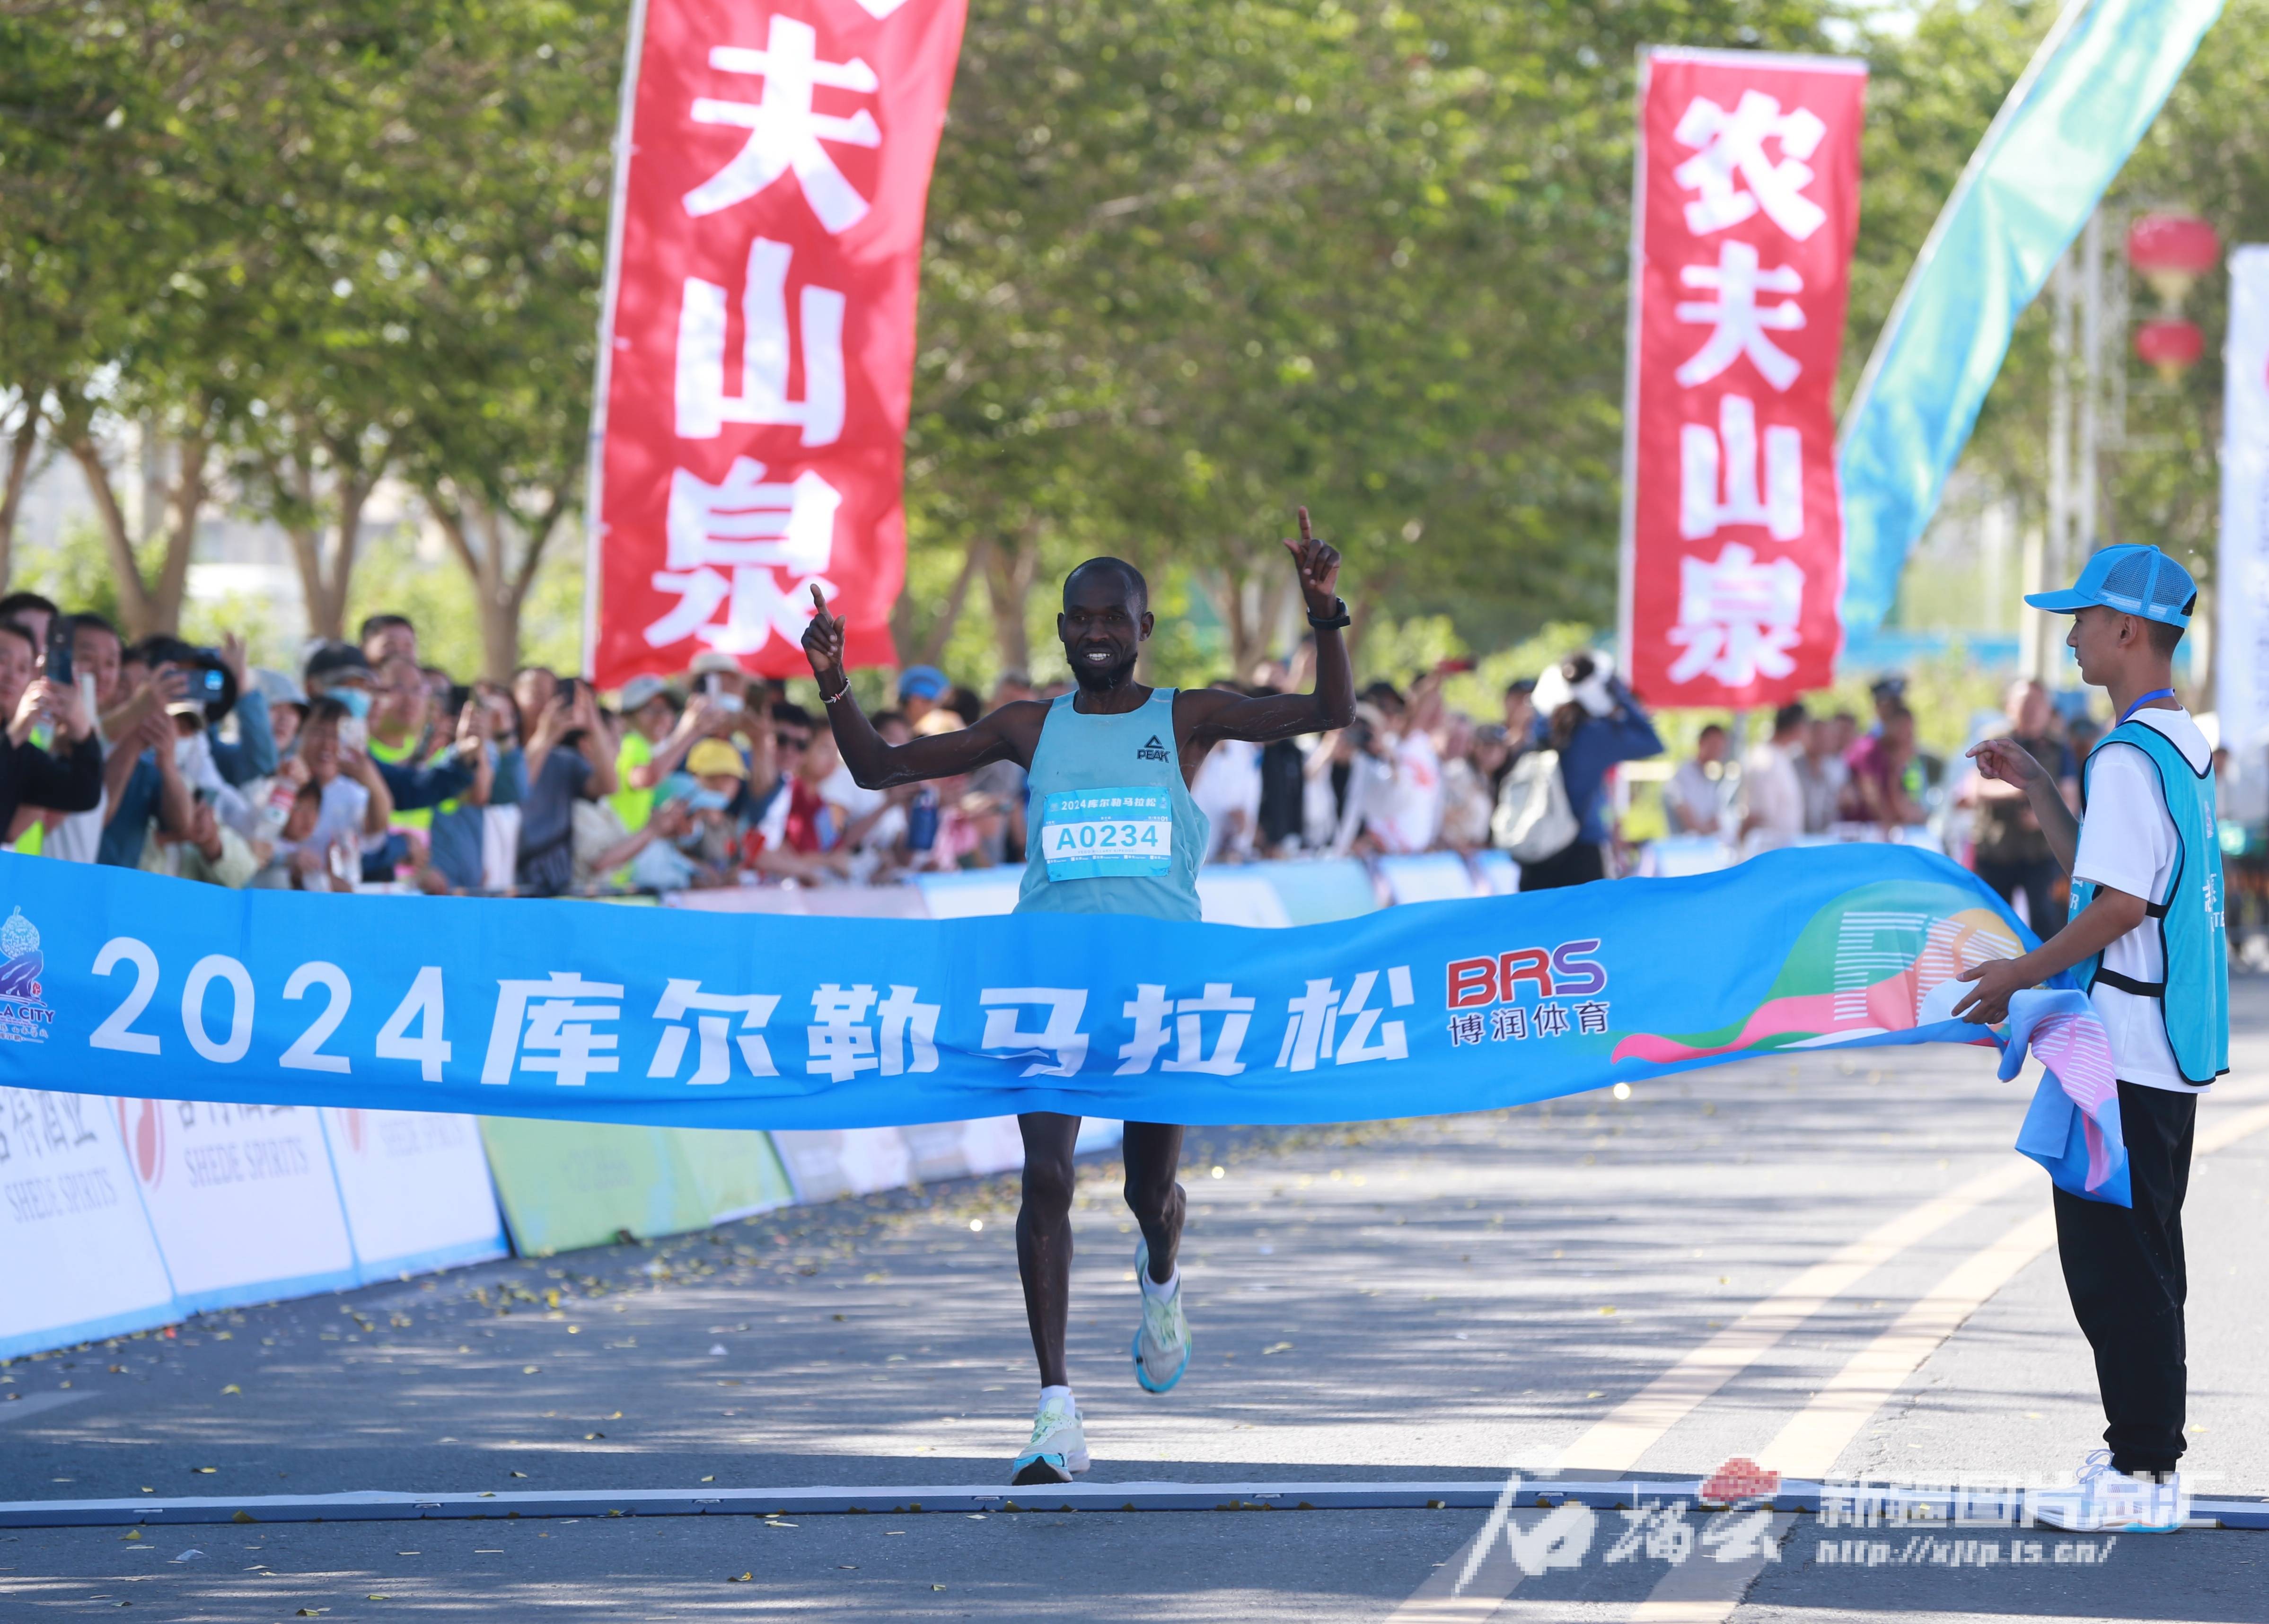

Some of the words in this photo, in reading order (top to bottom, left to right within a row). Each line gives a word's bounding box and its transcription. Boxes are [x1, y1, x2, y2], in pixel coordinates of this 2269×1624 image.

[643, 0, 906, 654] 夫山泉
[1667, 89, 1828, 688] 农夫山泉
[1136, 749, 1170, 764] PEAK
[1061, 798, 1156, 810] 2024库尔勒马拉松
[1056, 825, 1158, 851] A0234
[1447, 939, 1608, 1010] BRS
[0, 1003, 15, 1018] A
[18, 1006, 55, 1024] CITY
[89, 937, 1415, 1087] 2024库尔勒马拉松
[1447, 1000, 1609, 1048] 博润体育
